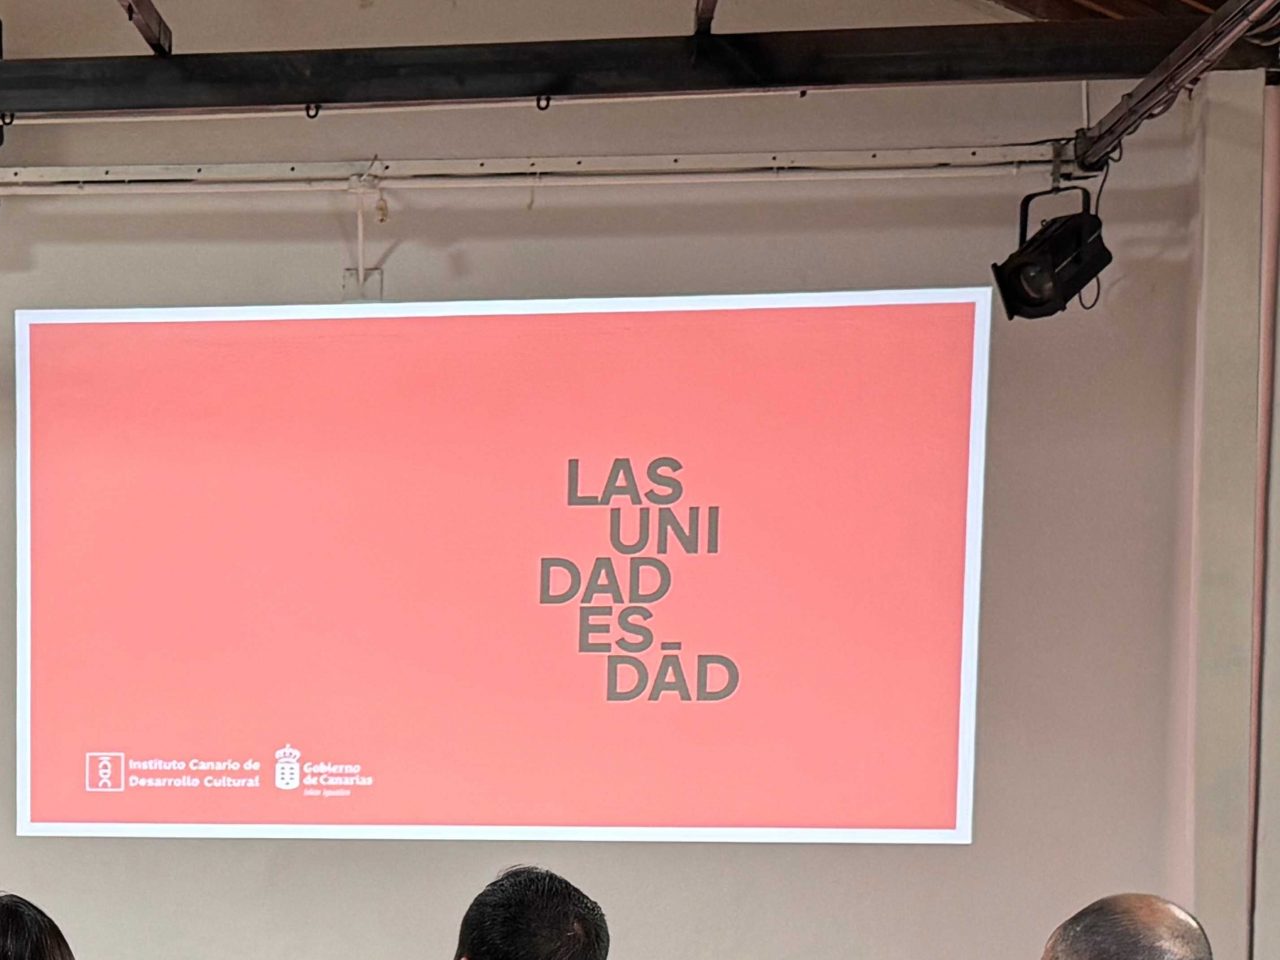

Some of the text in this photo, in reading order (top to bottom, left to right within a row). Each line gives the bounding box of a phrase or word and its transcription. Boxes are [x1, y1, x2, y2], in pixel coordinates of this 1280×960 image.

[567, 456, 683, 506] LAS
[610, 506, 720, 555] UNI
[539, 556, 672, 605] DAD
[578, 605, 654, 653] ES
[606, 641, 740, 701] DĀD
[129, 759, 261, 770] Instituto Canario de
[129, 775, 260, 787] Desarrollo Cultural
[303, 762, 361, 774] Gobierno
[303, 774, 373, 785] de Canarias
